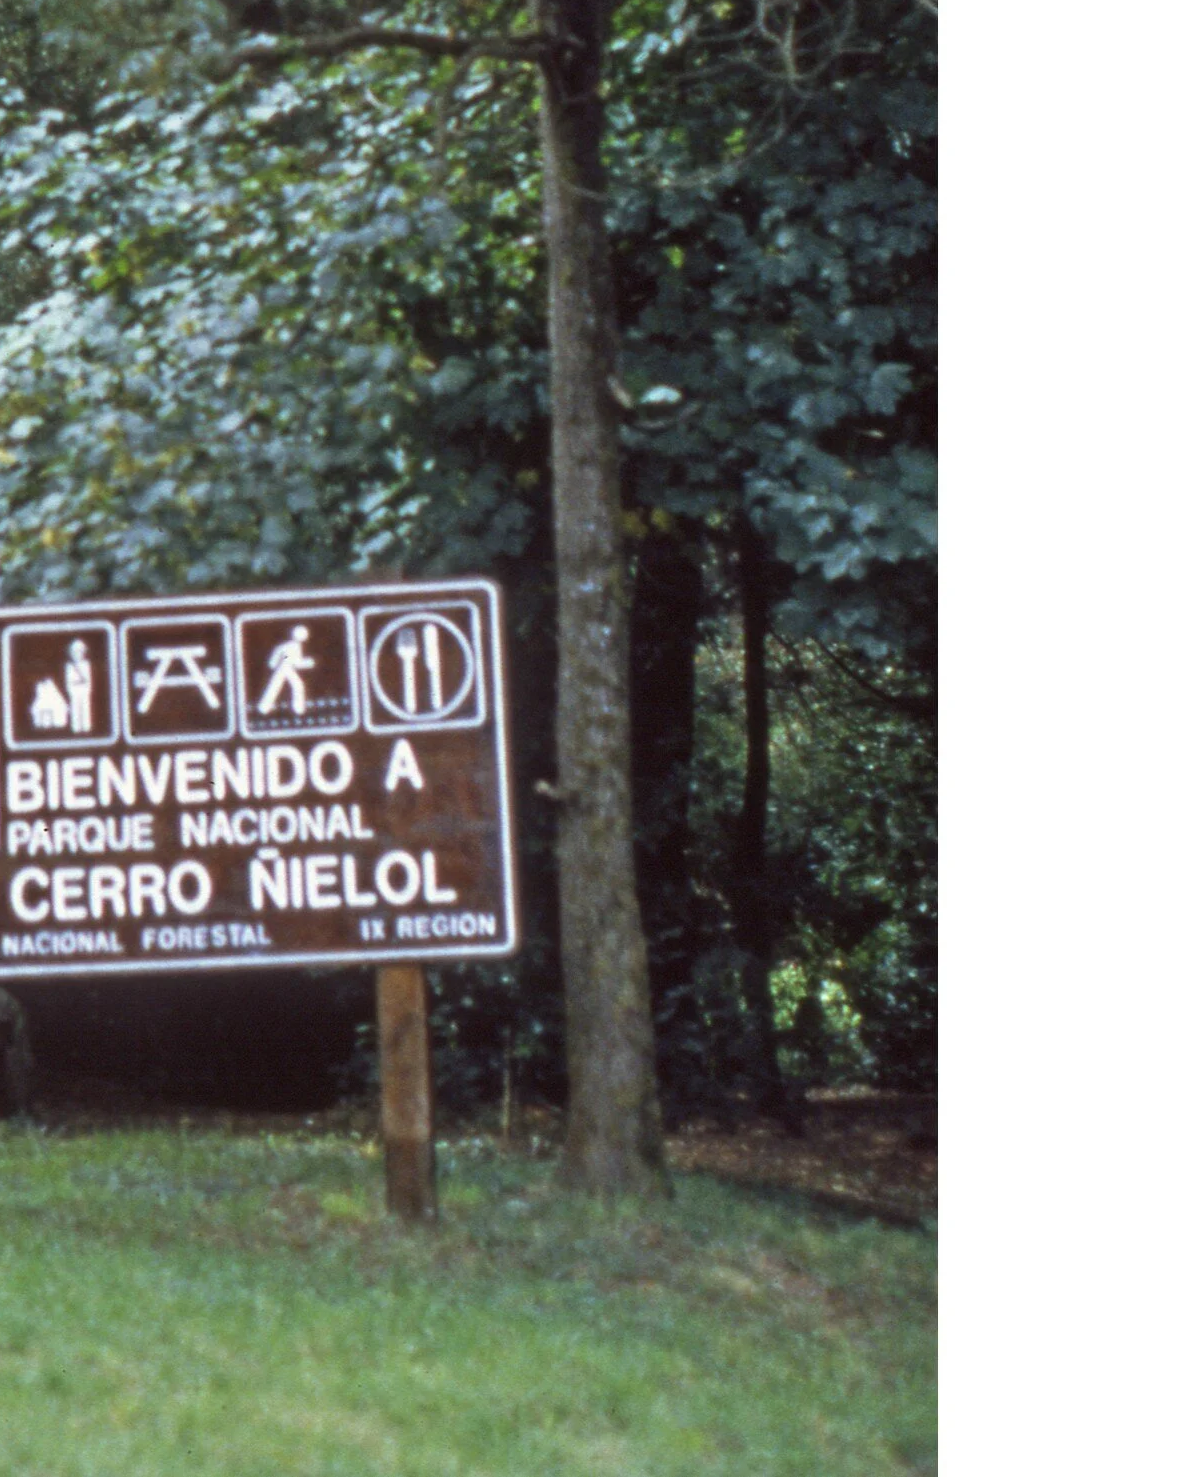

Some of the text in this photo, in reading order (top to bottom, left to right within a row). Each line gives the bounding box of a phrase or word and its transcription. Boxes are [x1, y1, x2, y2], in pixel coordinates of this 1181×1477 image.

[6, 738, 425, 813] BIENVENIDO A
[6, 803, 374, 856] PARQUE NACIONAL
[9, 848, 457, 923] CERRO ÑIELOL
[1, 930, 123, 956] NACIONAL
[141, 923, 272, 952] FORESTAL
[360, 912, 496, 941] IX REGION
